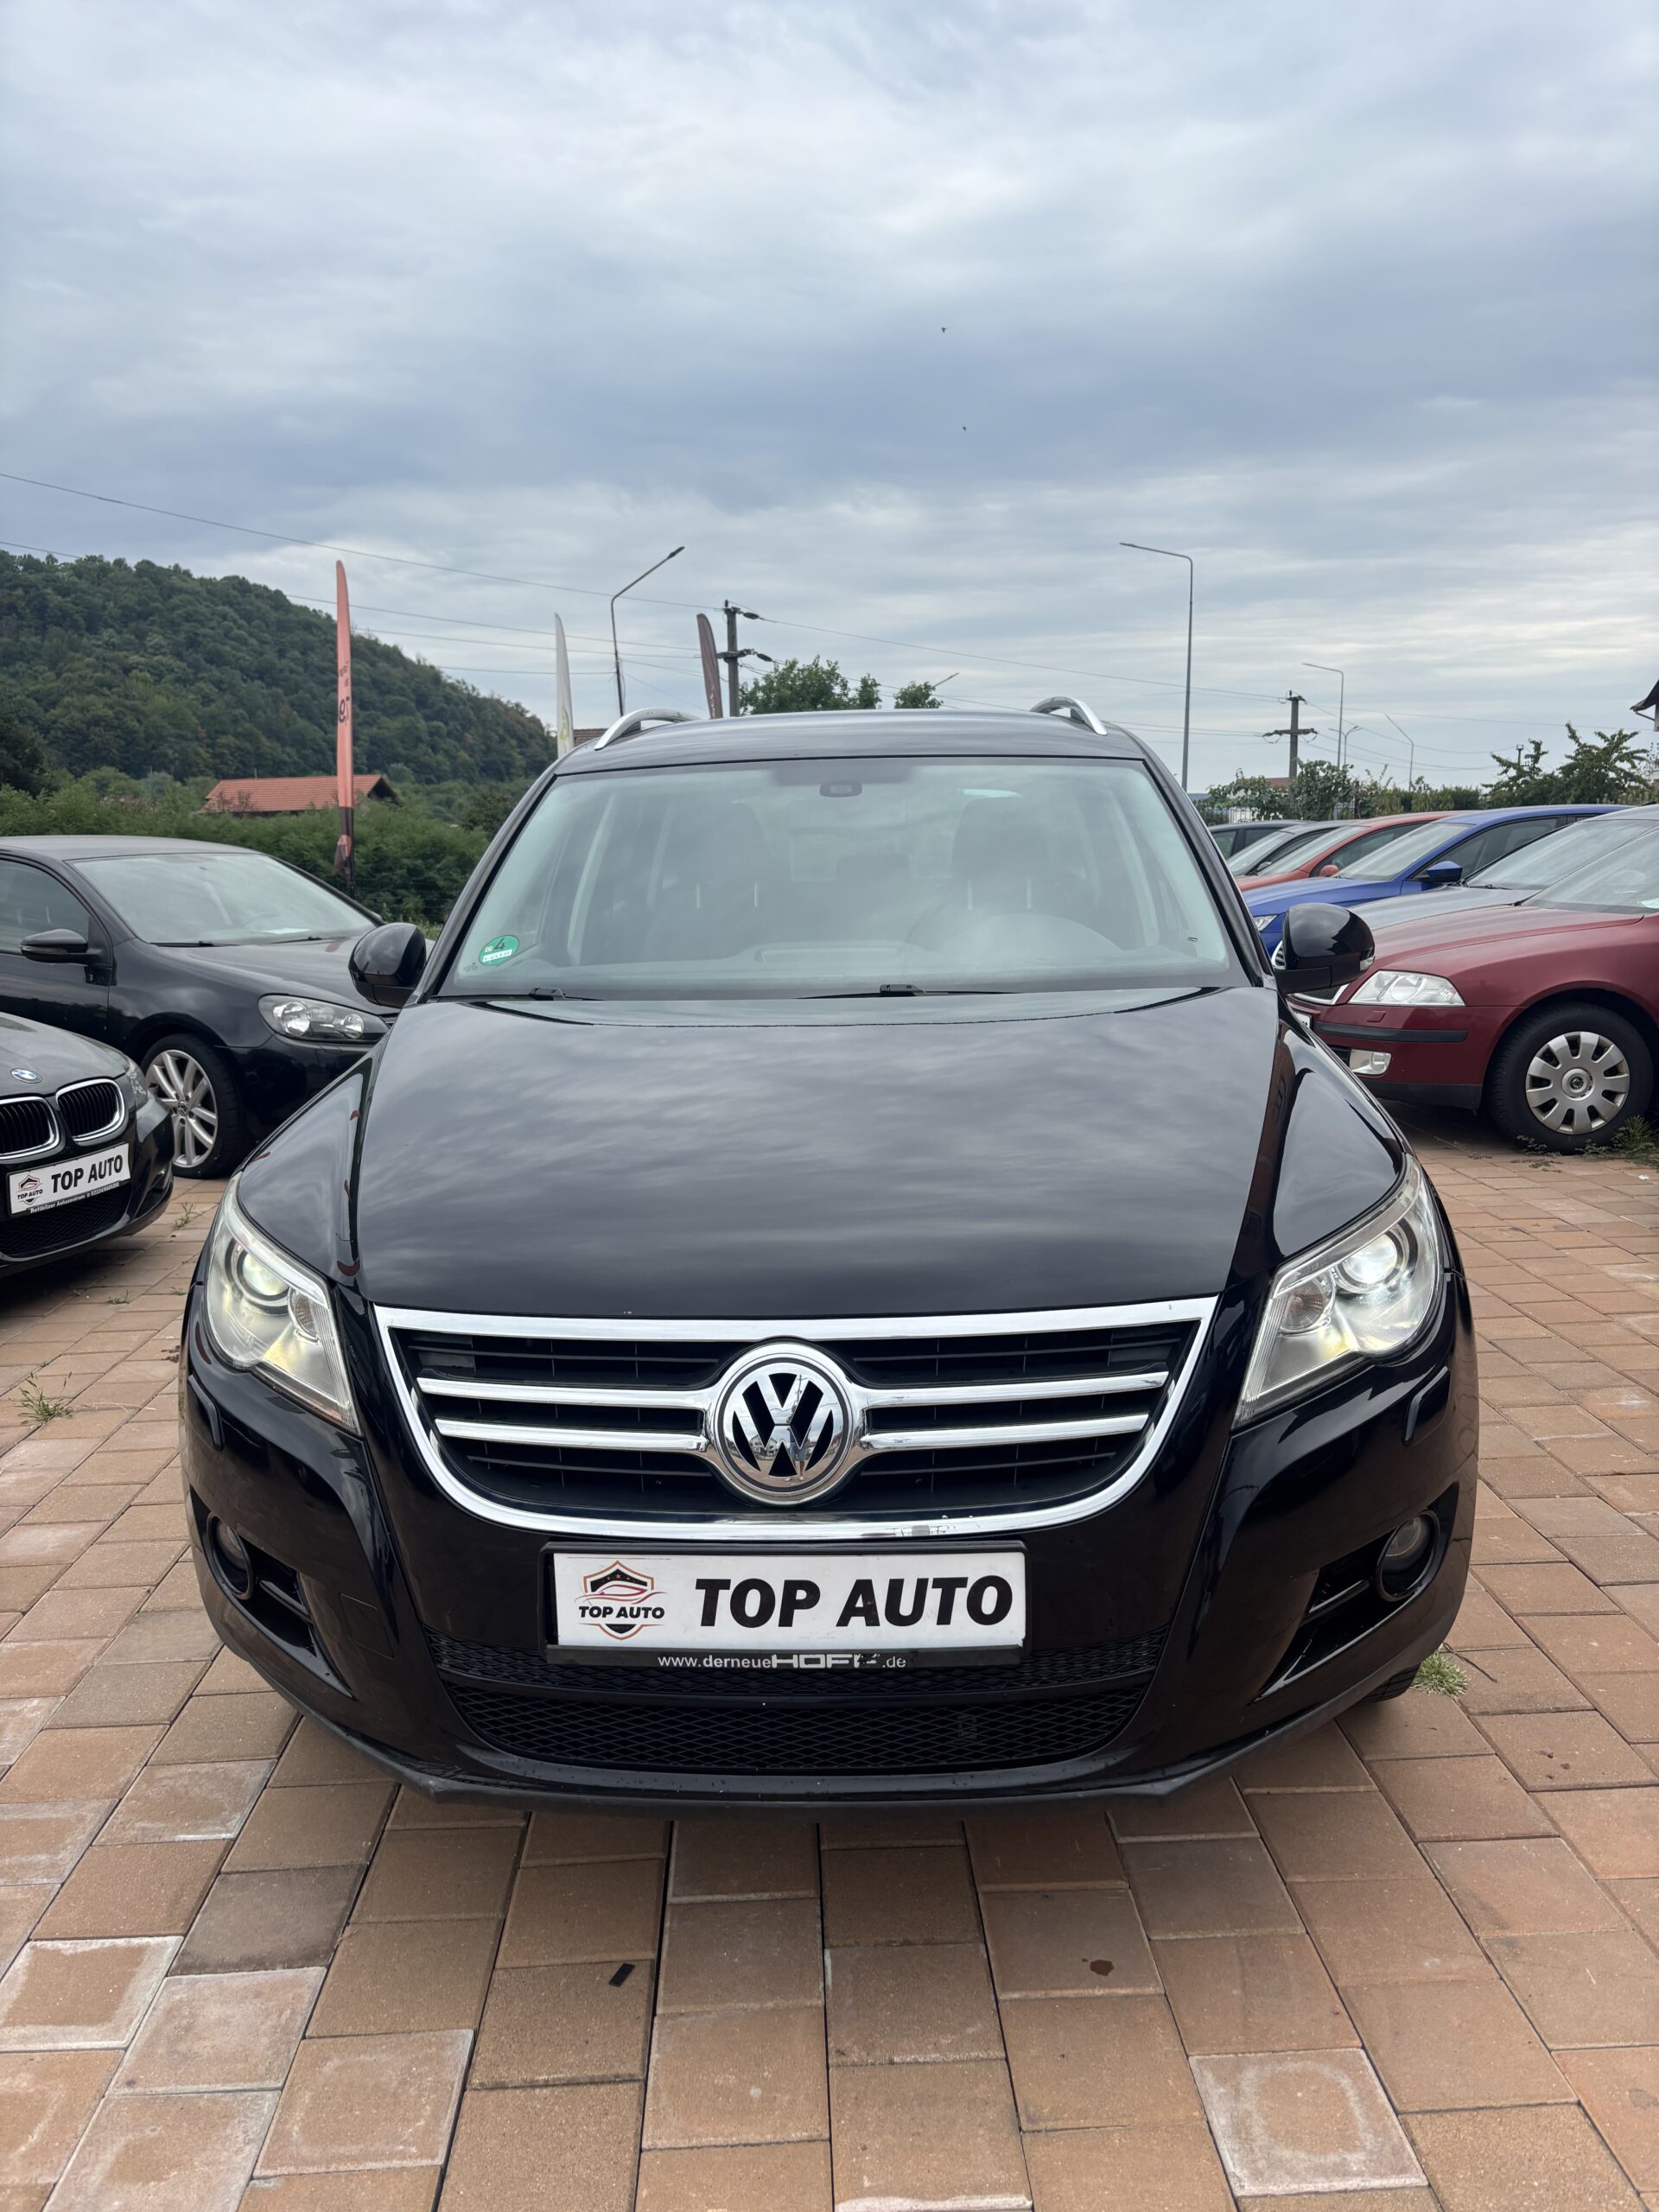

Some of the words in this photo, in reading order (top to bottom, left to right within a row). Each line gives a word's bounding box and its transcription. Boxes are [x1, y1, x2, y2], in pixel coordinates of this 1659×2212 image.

[493, 938, 505, 950] 4
[51, 1167, 85, 1193] TOP
[87, 1154, 124, 1183] AUTO
[29, 1189, 43, 1198] AUTO
[695, 1578, 821, 1628] TOP
[836, 1574, 1014, 1627] AUTO
[578, 1605, 613, 1618] TOP
[615, 1605, 665, 1619] AUTO
